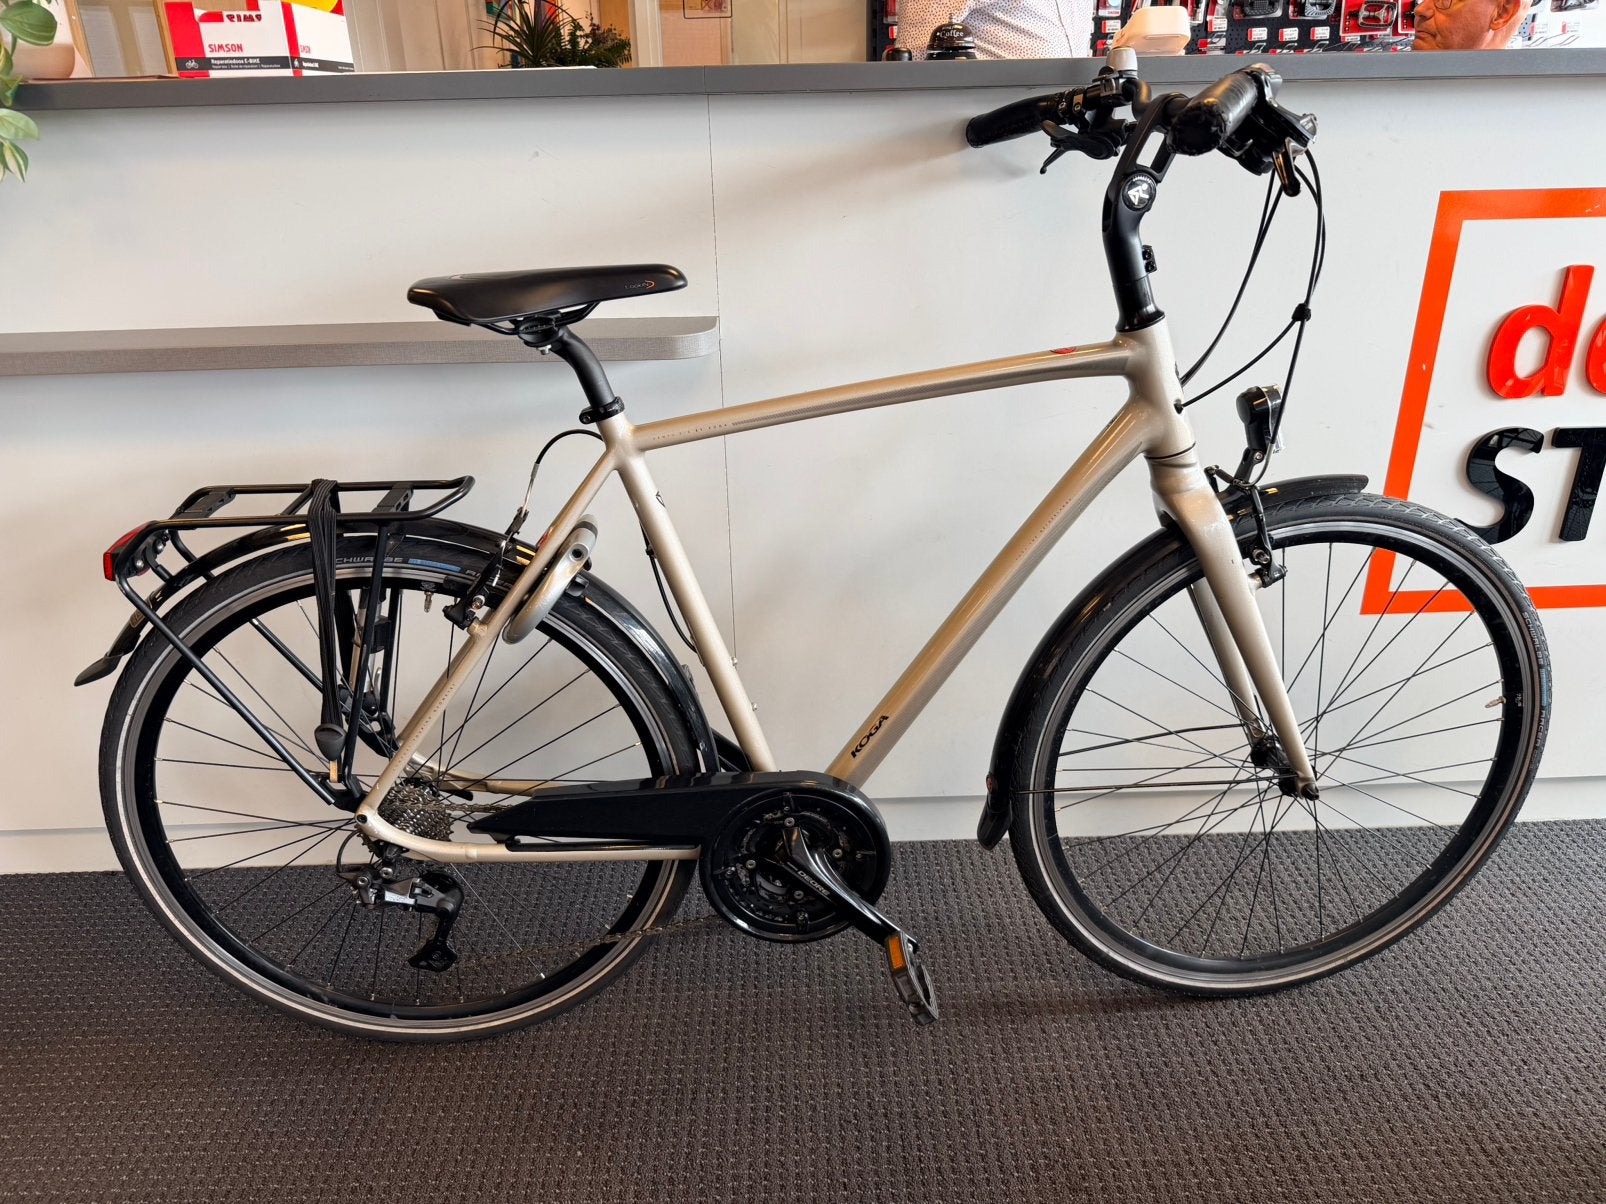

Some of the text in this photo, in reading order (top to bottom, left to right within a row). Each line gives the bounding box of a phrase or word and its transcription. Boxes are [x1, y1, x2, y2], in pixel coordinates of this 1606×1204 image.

[940, 29, 964, 38] Coffee
[208, 43, 243, 53] SIMSON
[1523, 611, 1544, 665] SCHWALBE
[850, 715, 889, 758] KOGA
[797, 870, 830, 896] DEORE
